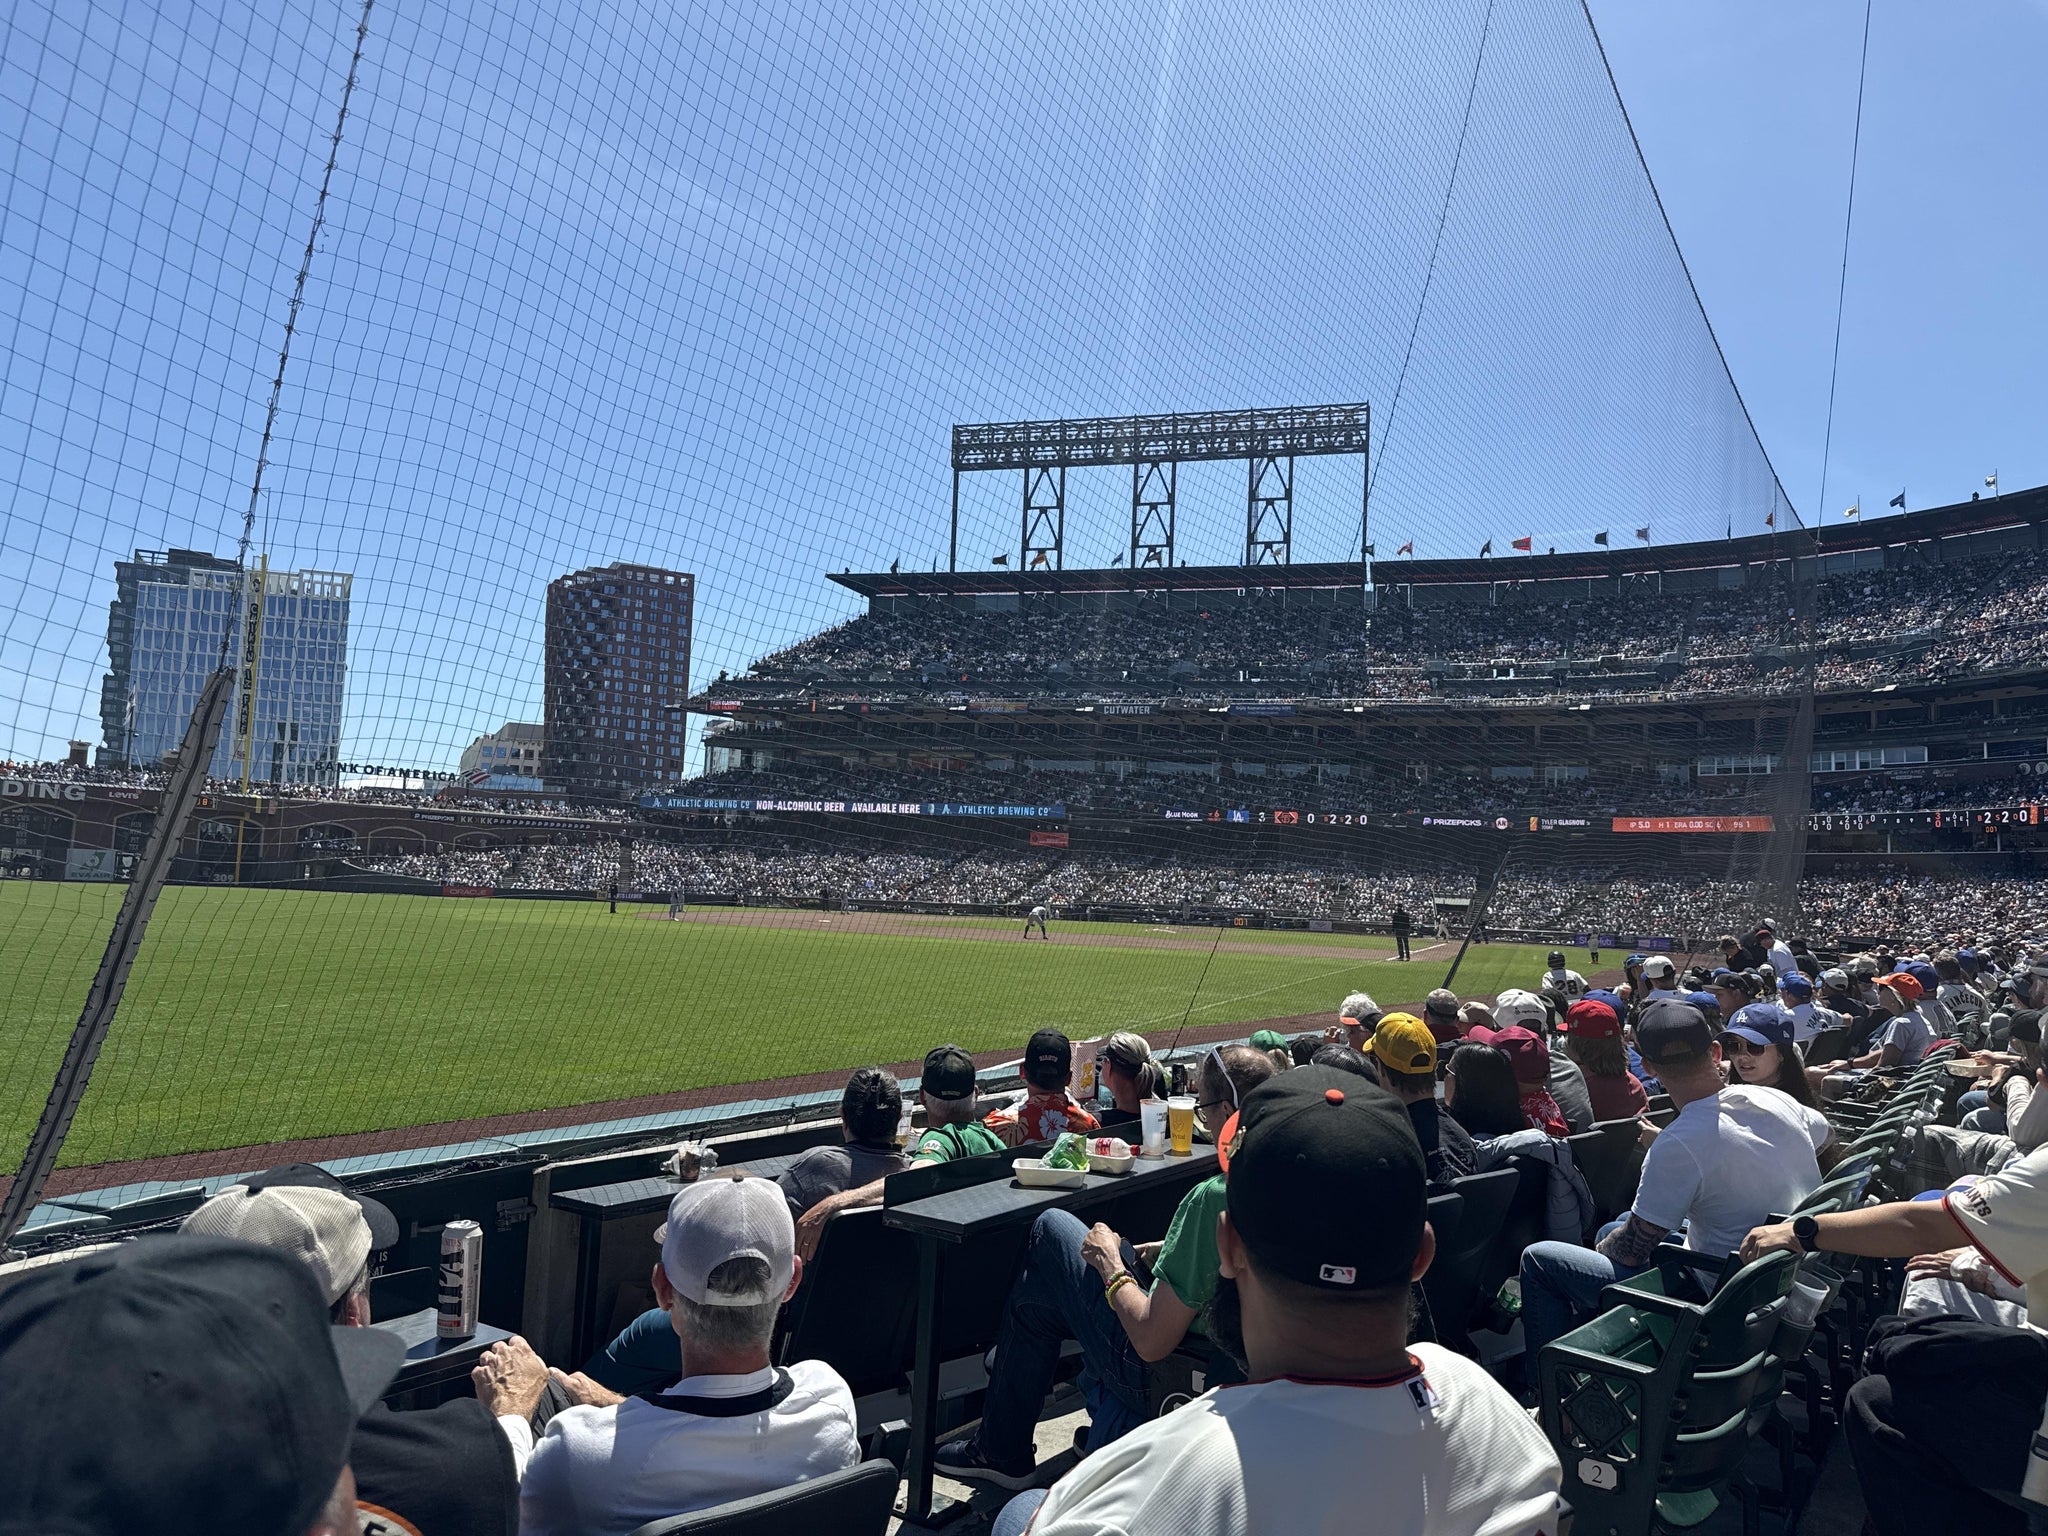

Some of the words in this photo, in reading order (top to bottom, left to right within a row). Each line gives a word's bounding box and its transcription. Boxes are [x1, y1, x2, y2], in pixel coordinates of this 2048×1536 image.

[1103, 705, 1150, 715] CUTWATER
[314, 761, 360, 774] BANK
[362, 765, 384, 777] OF
[388, 767, 456, 782] AMERICA
[2, 780, 87, 800] DING
[667, 799, 701, 808] ATHLETIC
[704, 799, 738, 809] BREWING
[756, 800, 822, 811] NON-ALCOHOLIC
[824, 801, 845, 812] BEER
[851, 802, 897, 813] AVAILABLE
[899, 803, 921, 814] HERE
[958, 805, 994, 815] ATHLETIC
[998, 806, 1035, 816] BREWING
[1165, 809, 1181, 819] BLUE
[1181, 811, 1199, 819] MOON
[1258, 811, 1266, 822] 3
[1307, 813, 1314, 823] 0
[1330, 814, 1336, 824] 2
[1345, 814, 1351, 824] 2
[1360, 814, 1367, 825] 0
[1826, 815, 1832, 823] 0
[1844, 815, 1850, 823] 2
[1935, 812, 1941, 820] 3
[1984, 811, 1991, 823] 2
[2001, 811, 2009, 823] 2
[2019, 810, 2027, 822] 0
[1433, 818, 1482, 827] PRIZEPICKS
[1541, 818, 1557, 826] TYLER
[1826, 823, 1832, 831] 0
[1844, 823, 1850, 831] 0
[1935, 820, 1941, 828] 0
[213, 873, 234, 883] 309
[449, 888, 488, 896] ORACLE
[1736, 1010, 1749, 1023] LA
[1526, 1113, 1546, 1131] LA
[1963, 1187, 1992, 1217] ANTS
[379, 1251, 388, 1262] IS
[1591, 1465, 1603, 1484] 2
